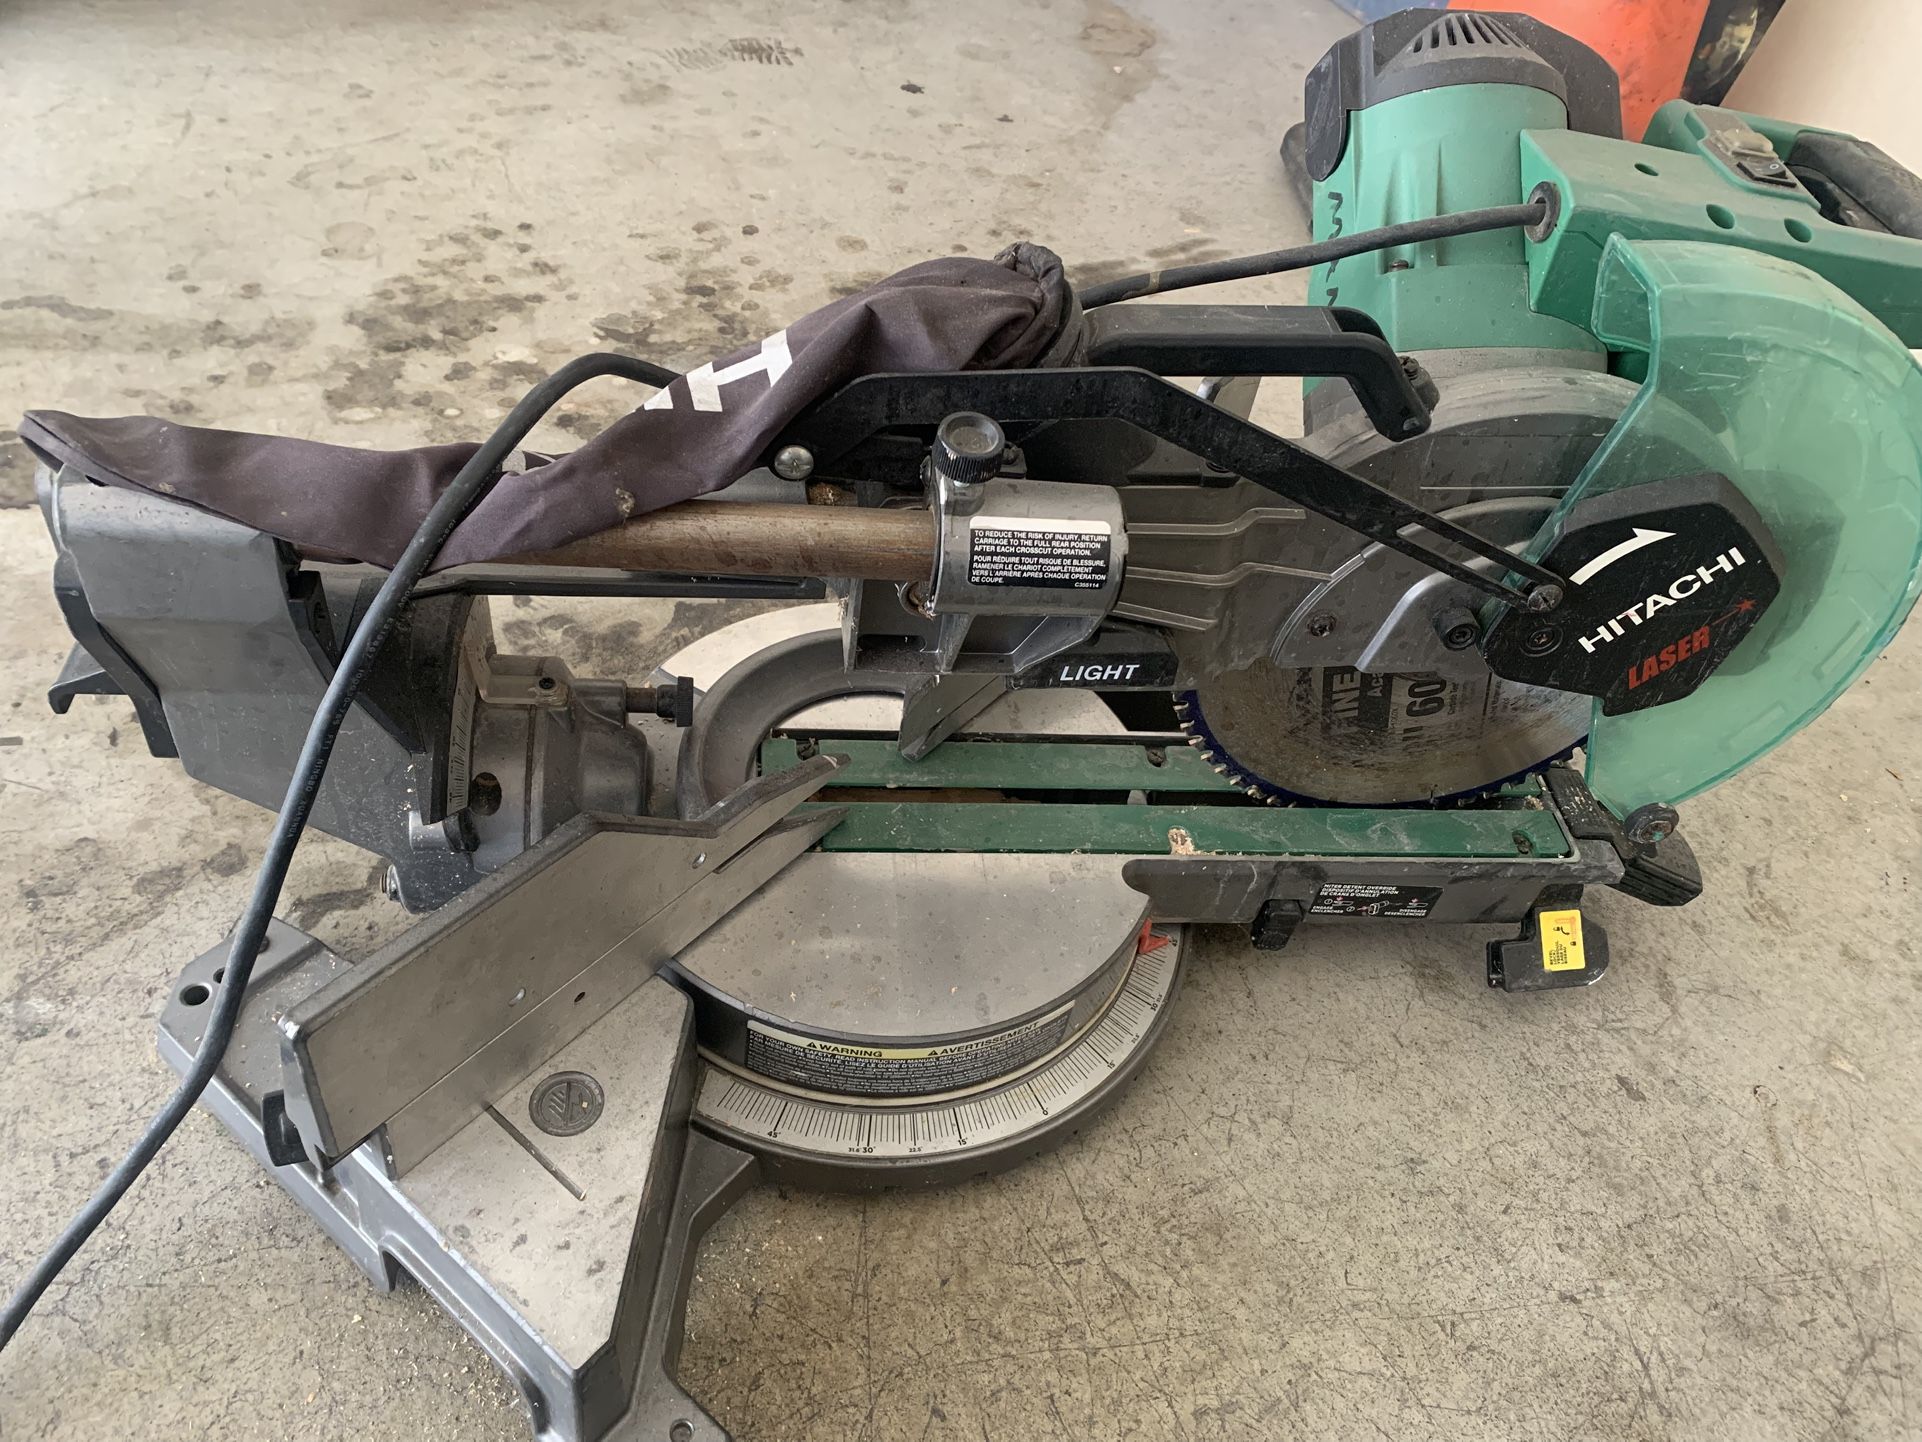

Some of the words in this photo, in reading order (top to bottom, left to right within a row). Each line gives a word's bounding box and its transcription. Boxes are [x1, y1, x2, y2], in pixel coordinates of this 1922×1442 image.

[985, 530, 1012, 538] REDUCE
[1010, 538, 1018, 546] TO
[1052, 548, 1092, 556] OPERATION.
[972, 562, 1004, 570] RAMENER
[1014, 564, 1041, 572] CHARIOT
[1044, 572, 1070, 580] CHAQUE
[1578, 547, 1746, 654] HITACHI
[1627, 626, 1710, 690] LASER
[1060, 664, 1140, 681] LIGHT
[750, 1030, 764, 1039] FOR
[765, 1036, 785, 1046] YOUR
[786, 1044, 804, 1052] OWN
[750, 1035, 764, 1044] PAR
[765, 1041, 794, 1054] MESURE
[940, 1021, 1040, 1054] AVERTISSEMENT
[820, 1044, 882, 1058] WARNING
